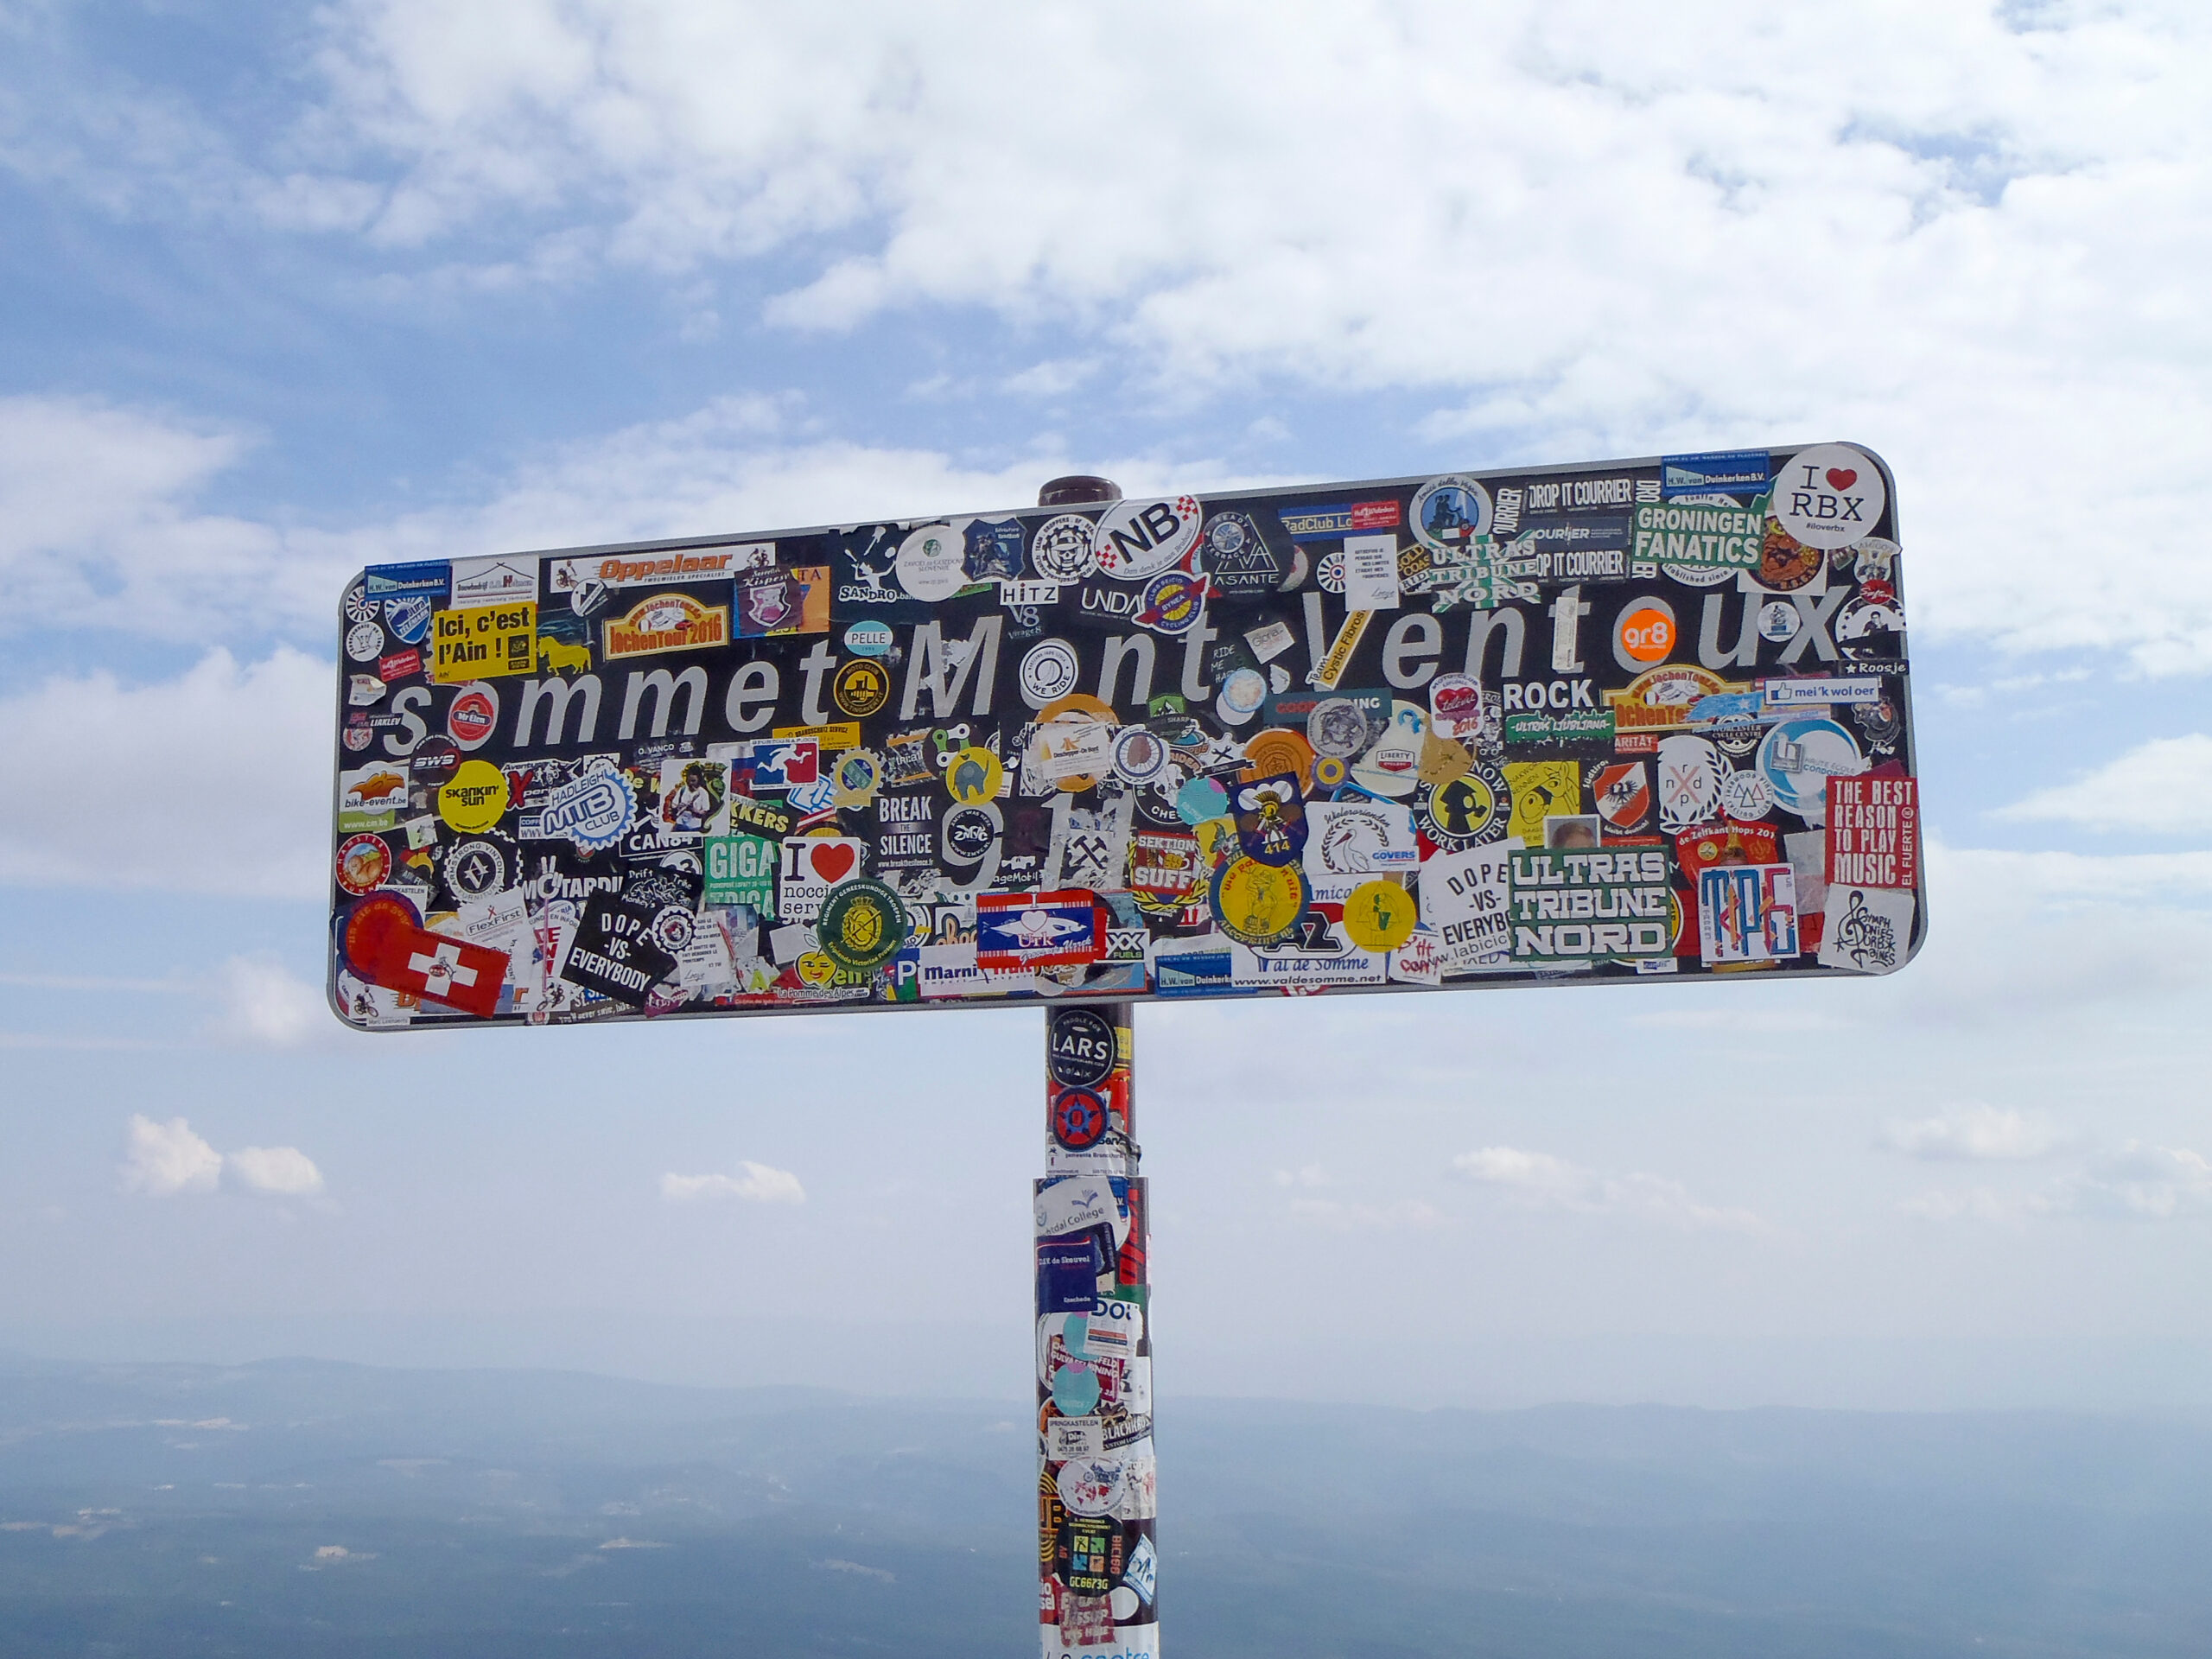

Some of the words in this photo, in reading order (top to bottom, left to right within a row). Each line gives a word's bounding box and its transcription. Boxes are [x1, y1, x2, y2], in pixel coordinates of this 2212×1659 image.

[1705, 474, 1750, 484] Duinkerken
[1529, 484, 1559, 508] DROP
[1561, 483, 1572, 506] IT
[1574, 479, 1631, 505] COURRIER
[1789, 492, 1864, 521] RBX
[1109, 502, 1180, 564] NB
[1638, 508, 1761, 535] GRONINGEN
[1635, 532, 1759, 566] FANATICS
[599, 554, 734, 582] Oppelaar
[1567, 550, 1624, 576] COURRIER
[438, 613, 470, 639] Ici,
[477, 607, 531, 632] c'est
[690, 614, 722, 645] 2016
[1007, 605, 1040, 628] V8
[851, 632, 886, 645] PELLE
[1624, 622, 1669, 649] gr8
[439, 641, 487, 665] l'Ain
[495, 638, 502, 658] !
[1859, 662, 1907, 676] Roosje
[1032, 683, 1047, 695] WE
[1052, 674, 1070, 694] RIDE
[1503, 679, 1594, 709] ROCK
[1795, 687, 1817, 696] mei
[1831, 687, 1853, 696] wol
[1855, 686, 1874, 696] oer
[414, 754, 455, 767] SWS
[647, 744, 675, 753] VANCO
[552, 770, 605, 804] HADLEIGH
[1471, 760, 1508, 793] NOW
[1835, 780, 1863, 804] THE
[1872, 780, 1913, 805] BEST
[543, 784, 616, 836] MTB
[584, 810, 620, 831] CLUB
[879, 796, 932, 823] BREAK
[1834, 805, 1897, 830] REASON
[900, 823, 910, 832] THE
[1420, 815, 1457, 852] WORK
[1461, 816, 1507, 851] LATER
[1690, 827, 1730, 841] Zelfkant
[1731, 826, 1754, 837] Hops
[880, 834, 932, 856] SILENCE
[1137, 836, 1197, 851] SEKTION
[1372, 850, 1415, 861] GOVERS
[1834, 830, 1852, 853] TO
[1860, 830, 1897, 854] PLAY
[1901, 821, 1912, 870] FUERTE
[451, 842, 481, 888] ARMSTRONG
[485, 843, 504, 875] VINTON
[709, 841, 772, 880] GIGA
[785, 842, 807, 881] I
[1512, 852, 1665, 887] ULTRAS
[1834, 853, 1897, 885] MUSIC
[1135, 868, 1192, 890] SUFF
[1446, 863, 1509, 896] DOPE
[1902, 872, 1912, 886] EL
[822, 895, 840, 926] REGIMENT
[838, 884, 888, 898] GENEESKUNDIGE
[1514, 887, 1668, 921] TRIBUNE
[468, 911, 521, 934] FlexFirst
[601, 912, 652, 947] DOPE
[604, 938, 632, 960] -VS-
[1018, 931, 1055, 948] Urk
[1515, 922, 1667, 957] NORD
[569, 947, 651, 993] EVERYBODY
[1234, 974, 1382, 986] www.valdesomme.net
[778, 988, 787, 999] La
[788, 988, 817, 999] Pomme
[817, 988, 834, 999] des
[834, 987, 854, 999] Alpes
[1052, 1033, 1109, 1061] LARS
[1066, 1207, 1105, 1226] College
